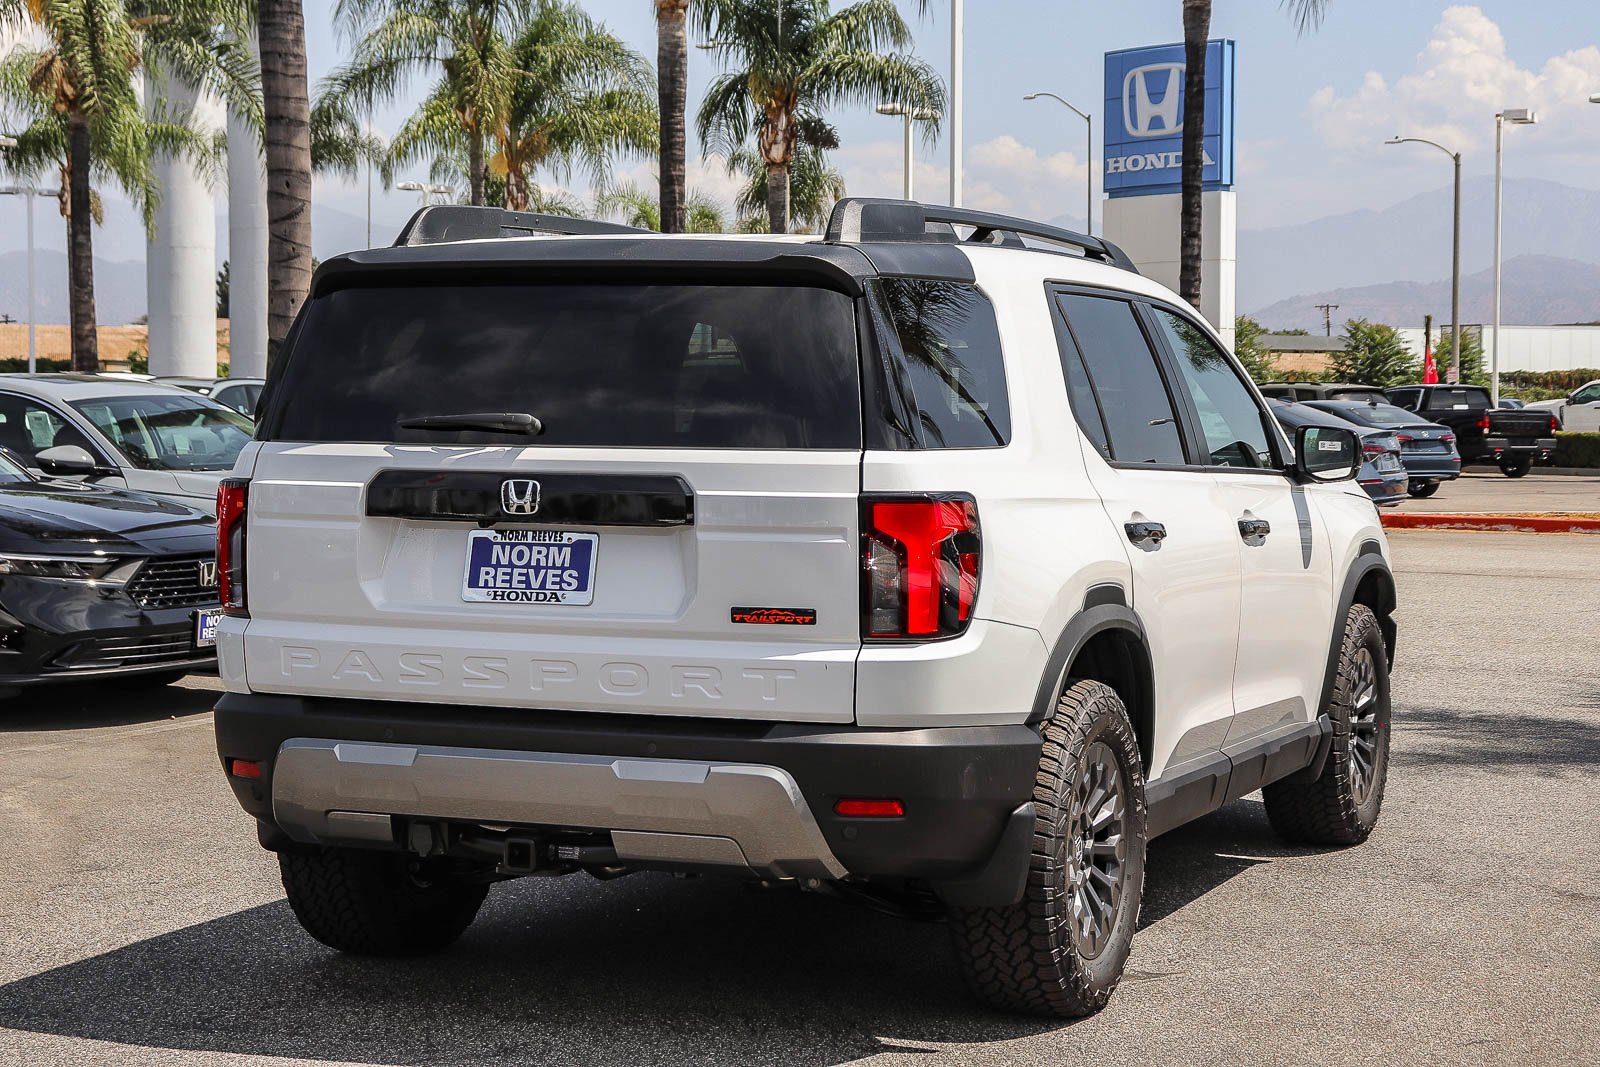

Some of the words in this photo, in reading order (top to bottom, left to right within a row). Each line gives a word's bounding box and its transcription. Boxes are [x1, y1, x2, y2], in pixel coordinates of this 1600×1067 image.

[500, 530, 529, 541] NORM
[531, 530, 564, 543] REEVES
[491, 544, 572, 567] NORM
[478, 566, 579, 591] REEVES
[490, 590, 562, 603] HONDA
[732, 613, 815, 625] TRAILSPORT
[278, 645, 797, 701] PASSPORT
